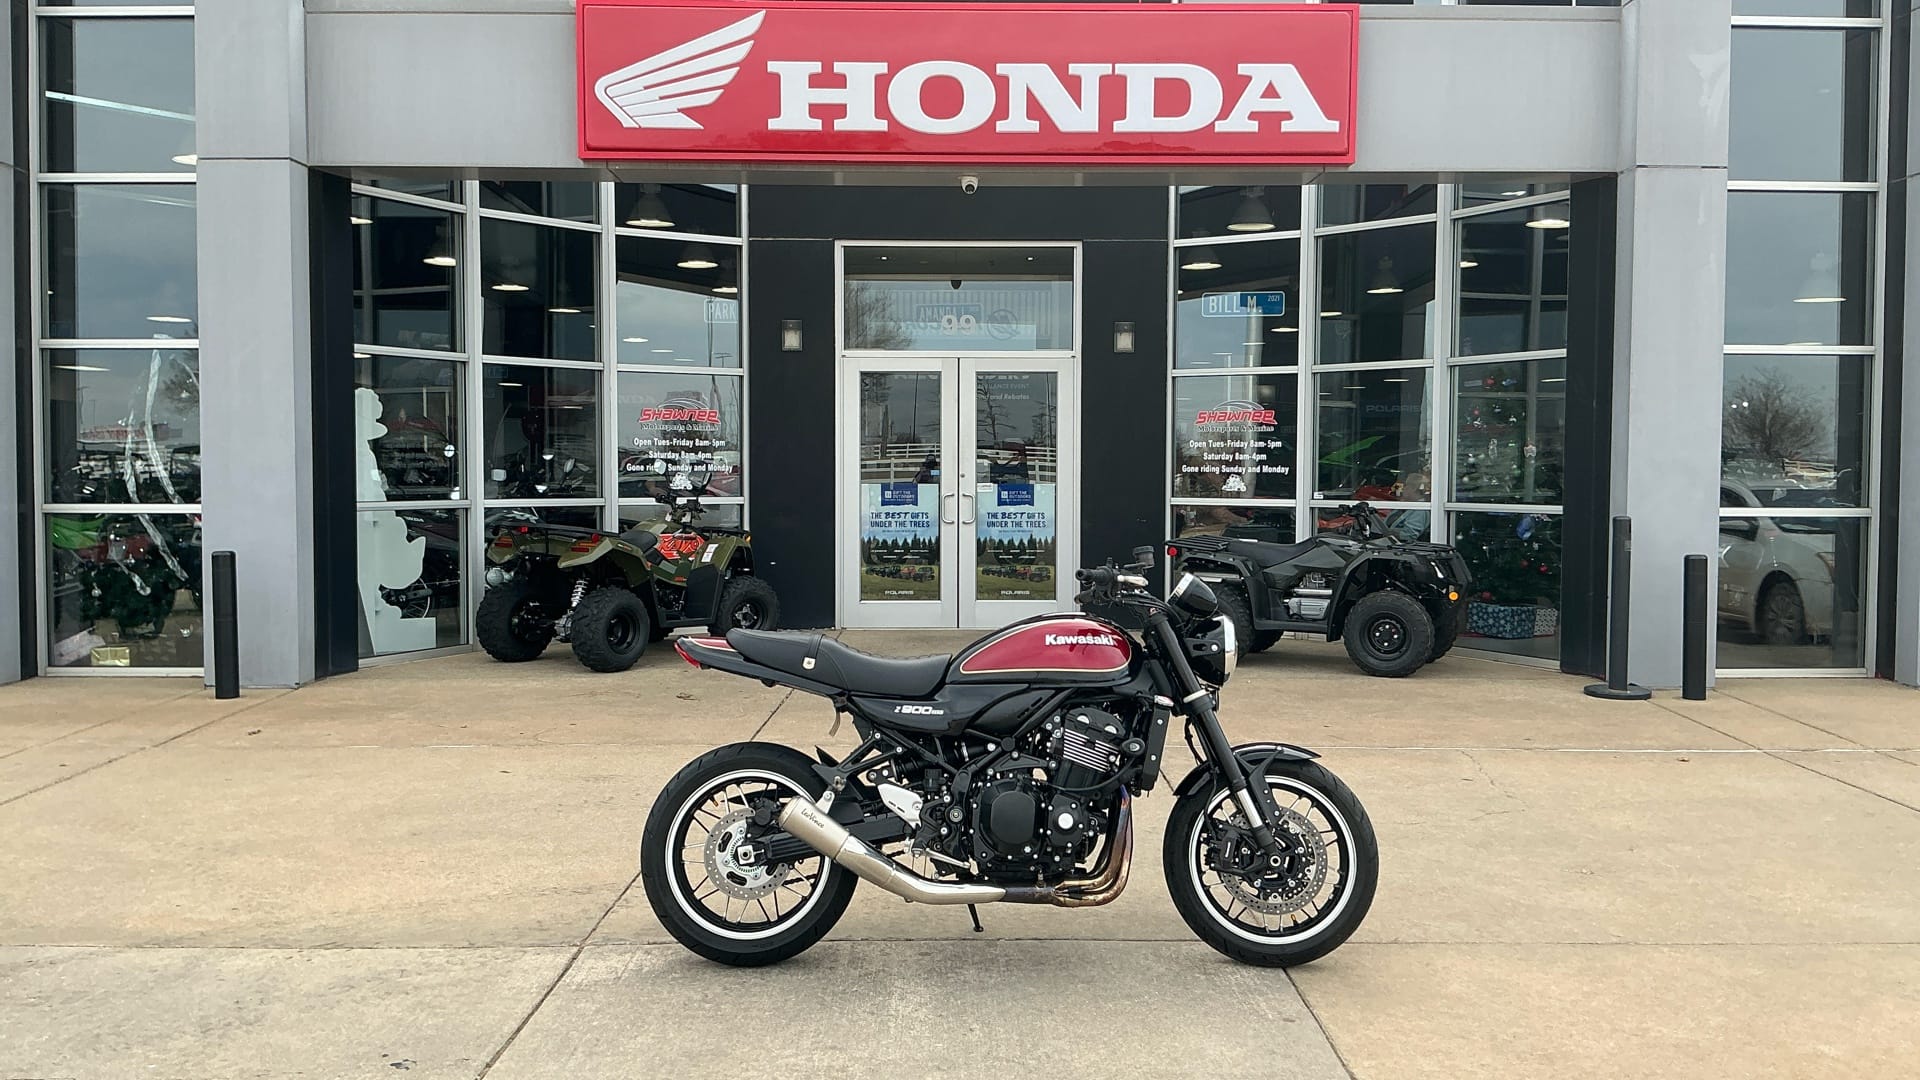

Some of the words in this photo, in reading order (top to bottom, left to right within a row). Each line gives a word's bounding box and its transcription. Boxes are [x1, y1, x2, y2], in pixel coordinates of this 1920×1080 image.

[767, 60, 1340, 134] HONDA
[1209, 295, 1241, 313] BILL
[1247, 295, 1262, 313] M.
[941, 314, 976, 335] 99
[633, 438, 652, 447] Open
[653, 438, 694, 448] Tues-Friday
[1189, 440, 1206, 448] Open
[1208, 440, 1248, 449] Tues-Friday
[648, 450, 680, 460] Saturday
[681, 451, 712, 460] 8am-4pm
[1203, 452, 1234, 462] Saturday
[1234, 452, 1267, 462] 8am-4pm
[626, 463, 644, 471] Gone
[667, 463, 692, 473] Sunday
[693, 463, 706, 471] and
[707, 463, 733, 473] Monday
[1181, 465, 1199, 473] Gone
[1200, 465, 1220, 474] riding
[1221, 465, 1247, 474] Sunday
[1247, 465, 1261, 473] and
[1262, 465, 1290, 475] Monday
[884, 511, 910, 519] BEST
[1000, 511, 1026, 519] BEST
[870, 520, 892, 528] UNDER
[895, 520, 908, 528] THE
[909, 520, 930, 528] TREES
[987, 520, 1009, 528] UNDER
[1011, 520, 1023, 528] THE
[1026, 520, 1046, 528] TREES
[1045, 634, 1114, 646] Kawasaki
